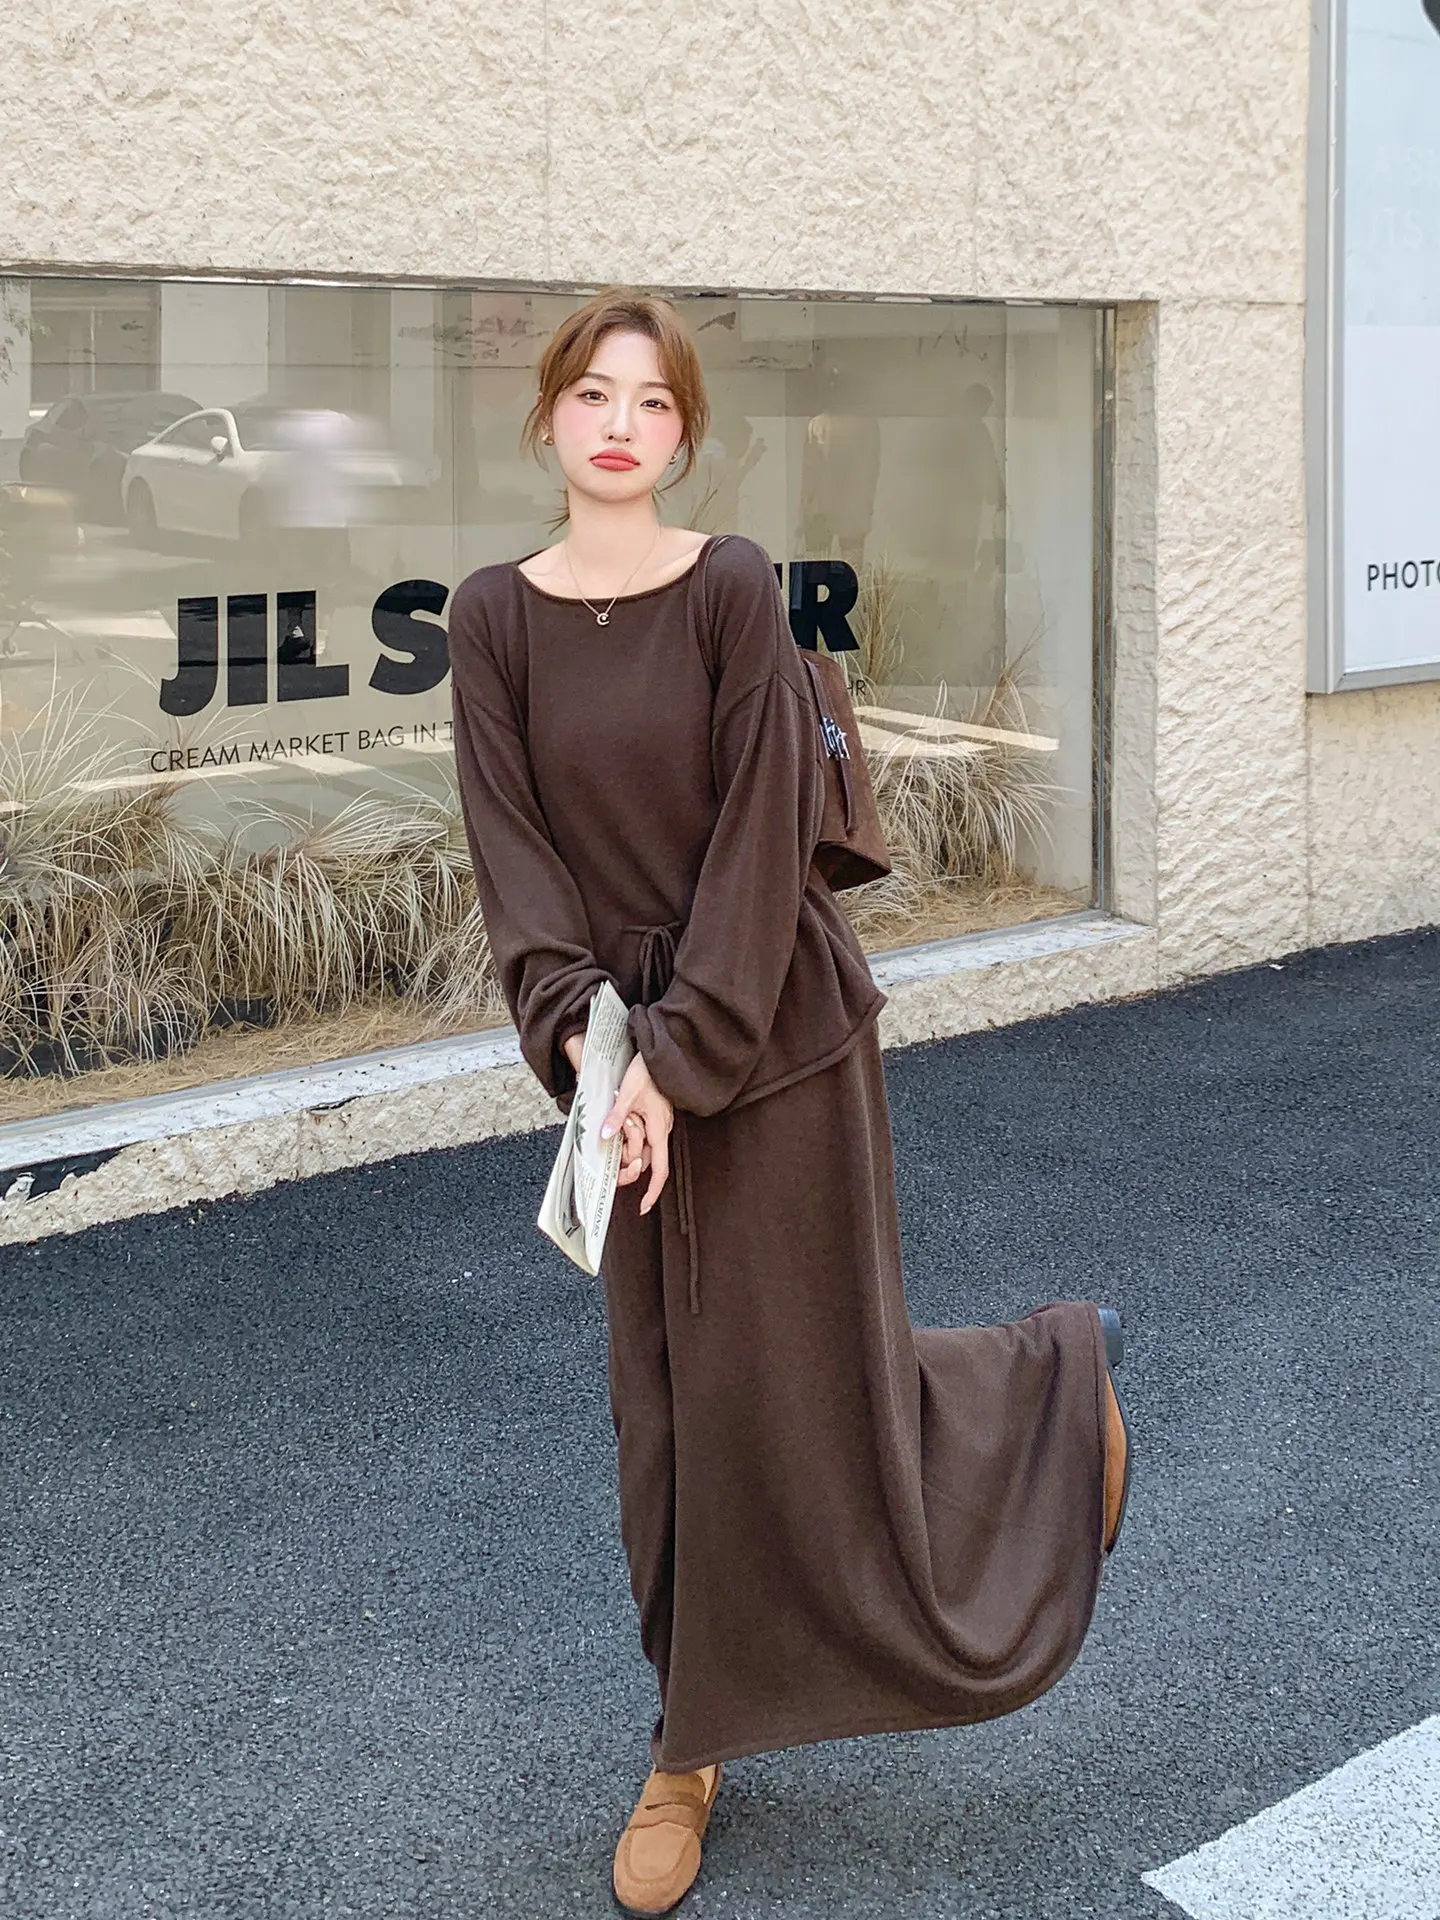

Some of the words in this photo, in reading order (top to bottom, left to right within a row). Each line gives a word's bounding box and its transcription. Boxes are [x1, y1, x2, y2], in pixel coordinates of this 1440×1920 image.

[159, 590, 350, 717] JIL
[369, 579, 453, 695] S
[773, 560, 861, 653] R
[151, 745, 241, 773] CREAM
[249, 732, 350, 762] MARKET
[358, 726, 405, 750] BAG
[414, 722, 437, 746] IN
